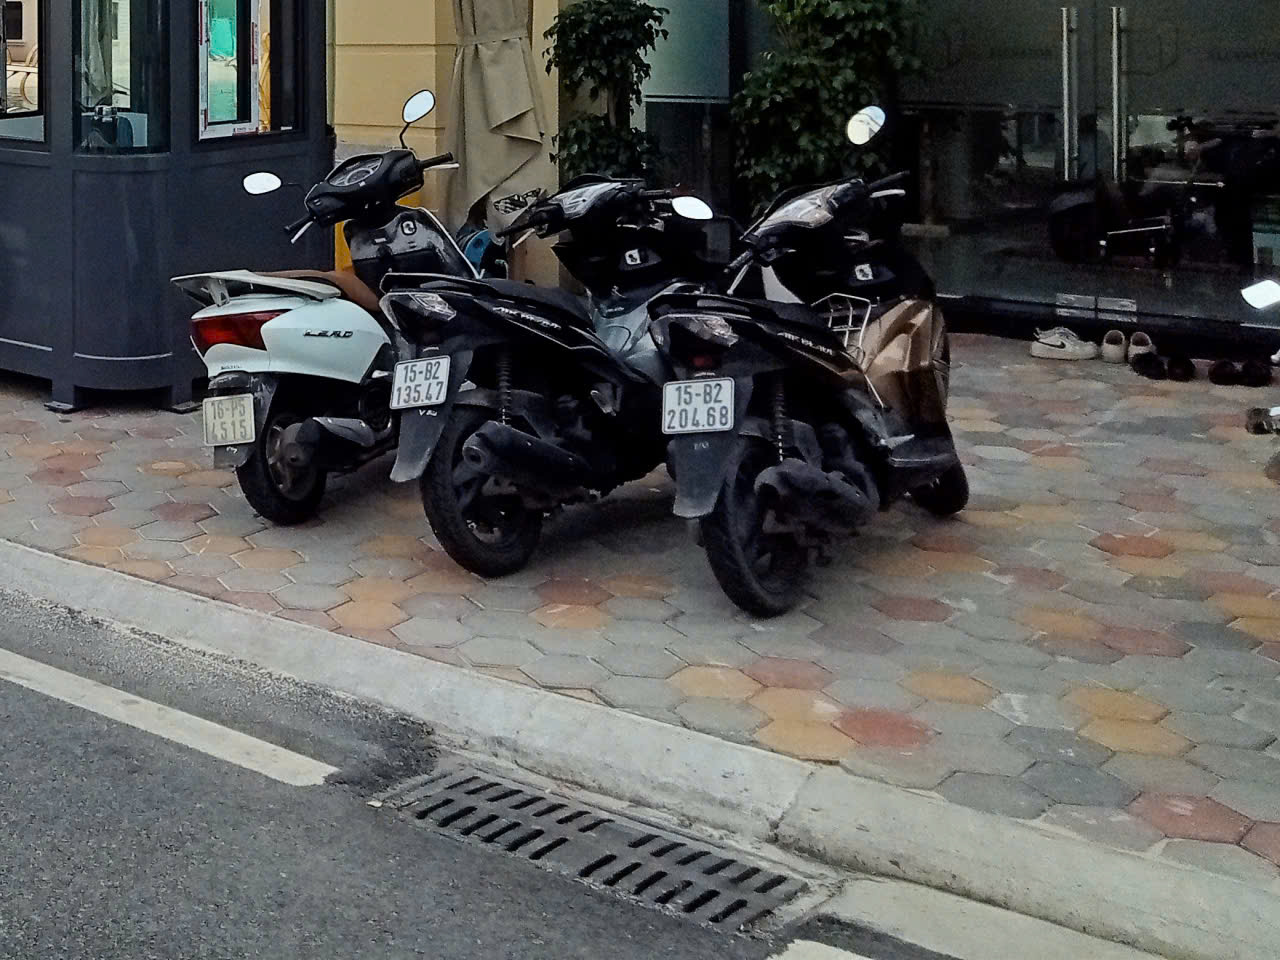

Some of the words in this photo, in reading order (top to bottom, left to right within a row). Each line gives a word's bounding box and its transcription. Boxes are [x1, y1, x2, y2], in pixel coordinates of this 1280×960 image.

[303, 330, 354, 339] LEAD
[403, 360, 441, 384] 15-B2
[396, 381, 444, 406] 135.47
[675, 383, 723, 406] 15-B2
[210, 398, 246, 420] 16-P5
[666, 405, 729, 430] 204.68
